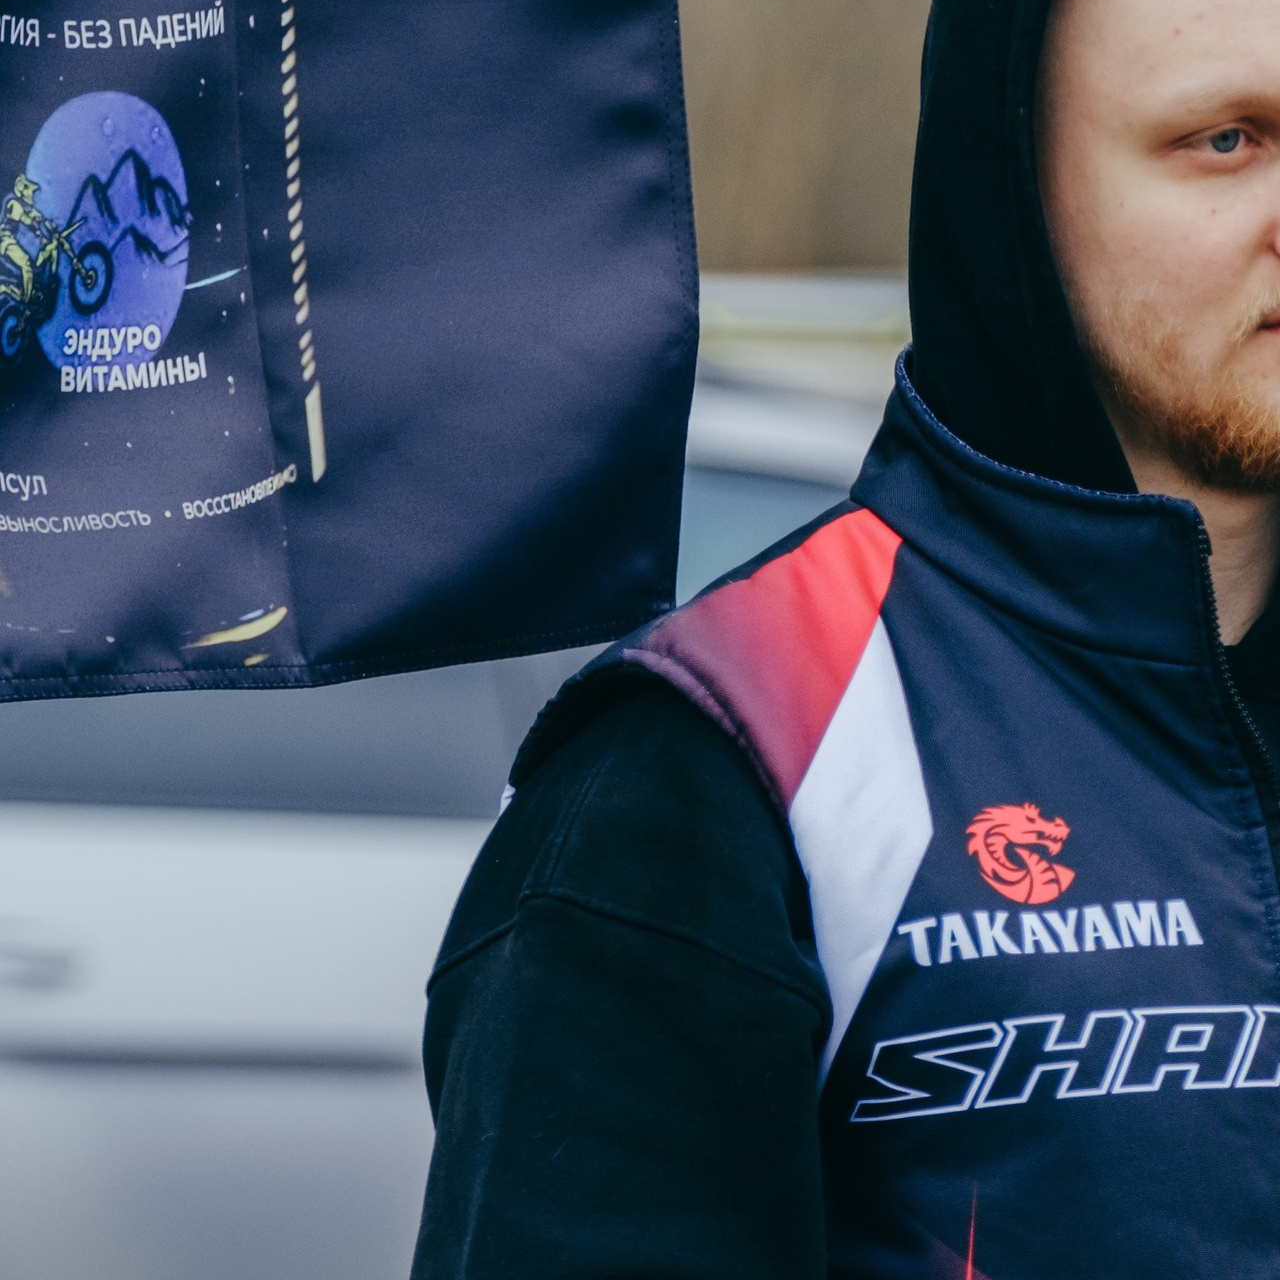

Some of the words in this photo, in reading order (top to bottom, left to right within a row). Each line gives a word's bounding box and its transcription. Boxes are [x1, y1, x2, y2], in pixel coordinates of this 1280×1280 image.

[63, 19, 113, 49] БЕЗ
[119, 0, 225, 50] ПАДЕНИЙ
[63, 324, 162, 361] ЭНДУРО
[60, 352, 207, 393] ВИТАМИНЫ
[898, 900, 1203, 967] TAKAYAMA
